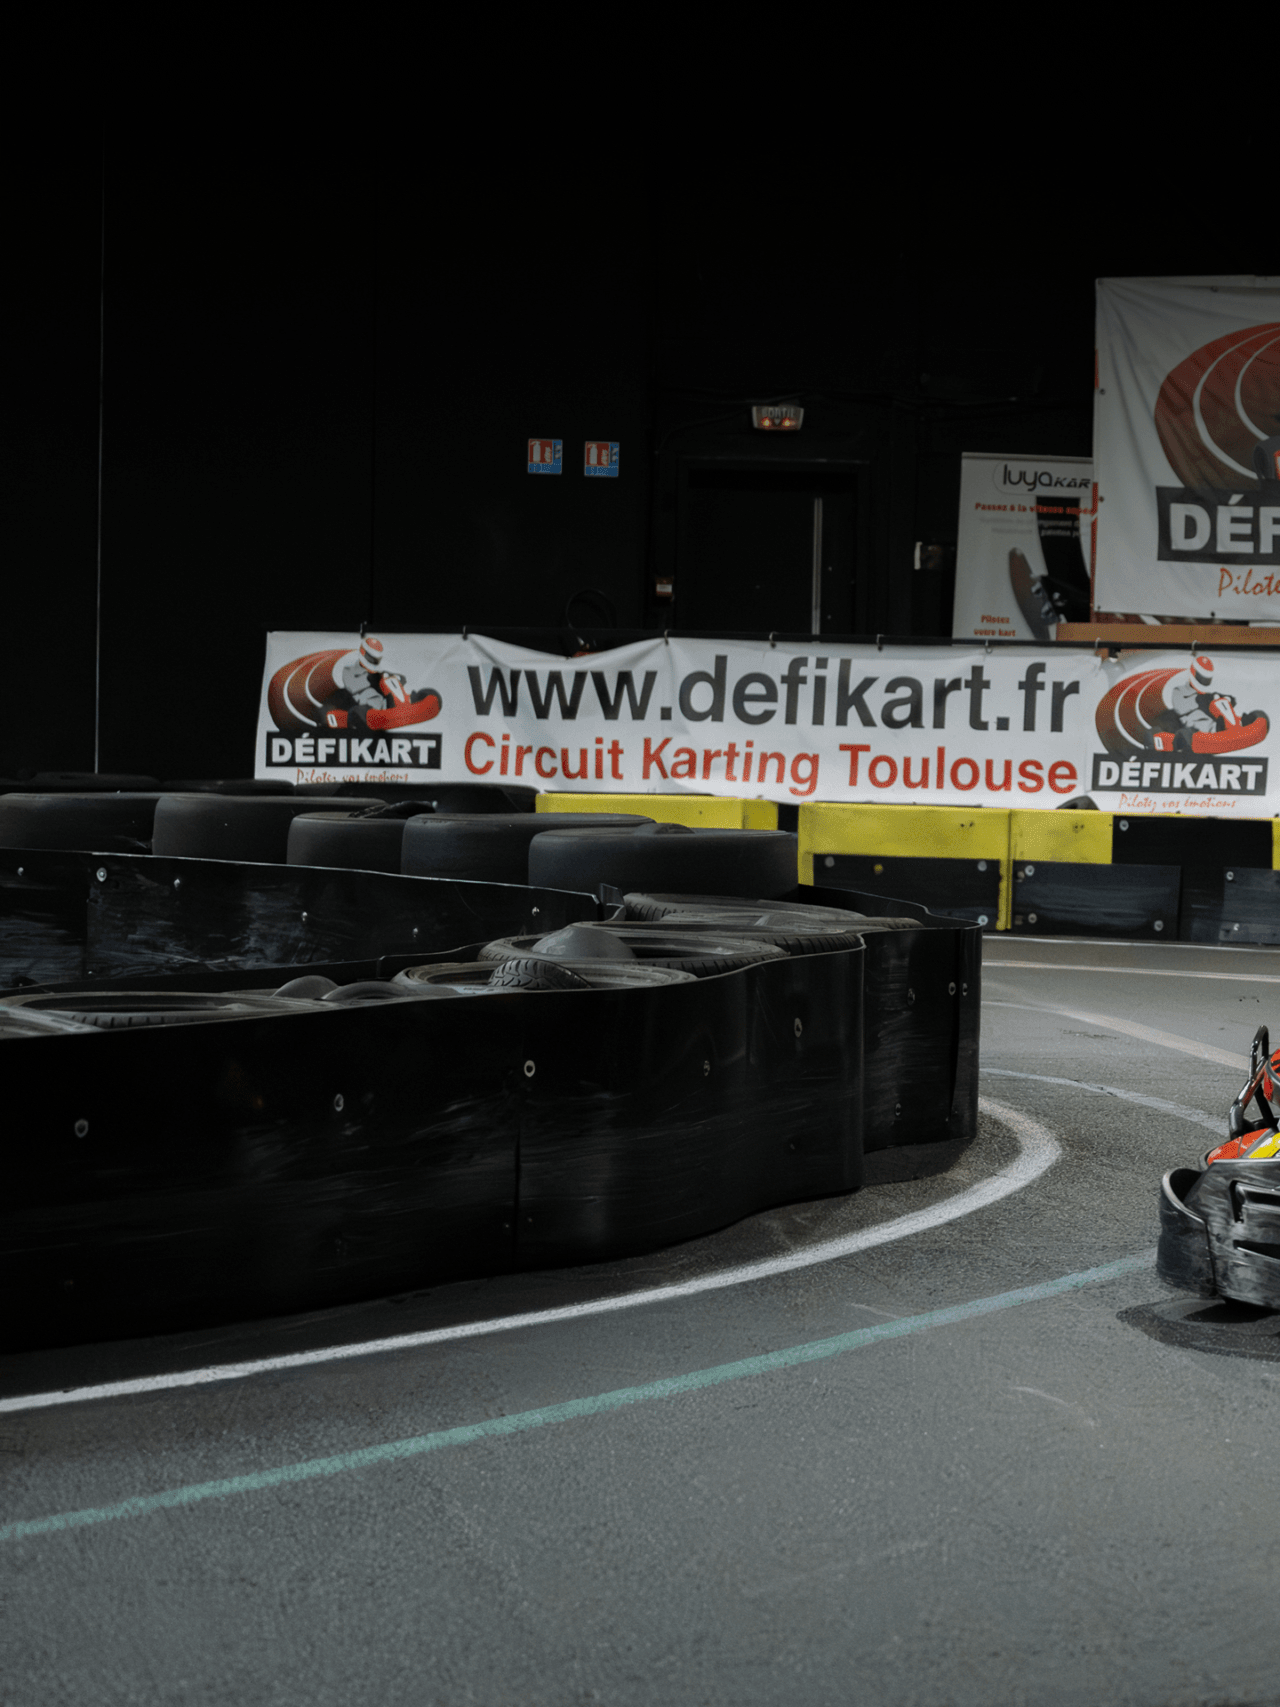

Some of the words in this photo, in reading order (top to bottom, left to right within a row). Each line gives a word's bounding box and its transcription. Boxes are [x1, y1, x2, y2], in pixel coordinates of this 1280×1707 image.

[467, 654, 1080, 733] www.defikart.fr
[271, 733, 437, 765] DÉFIKART
[464, 731, 624, 781] Circuit
[642, 736, 820, 797] Karting
[838, 742, 1079, 794] Toulouse
[1100, 754, 1264, 791] DÉFIKART
